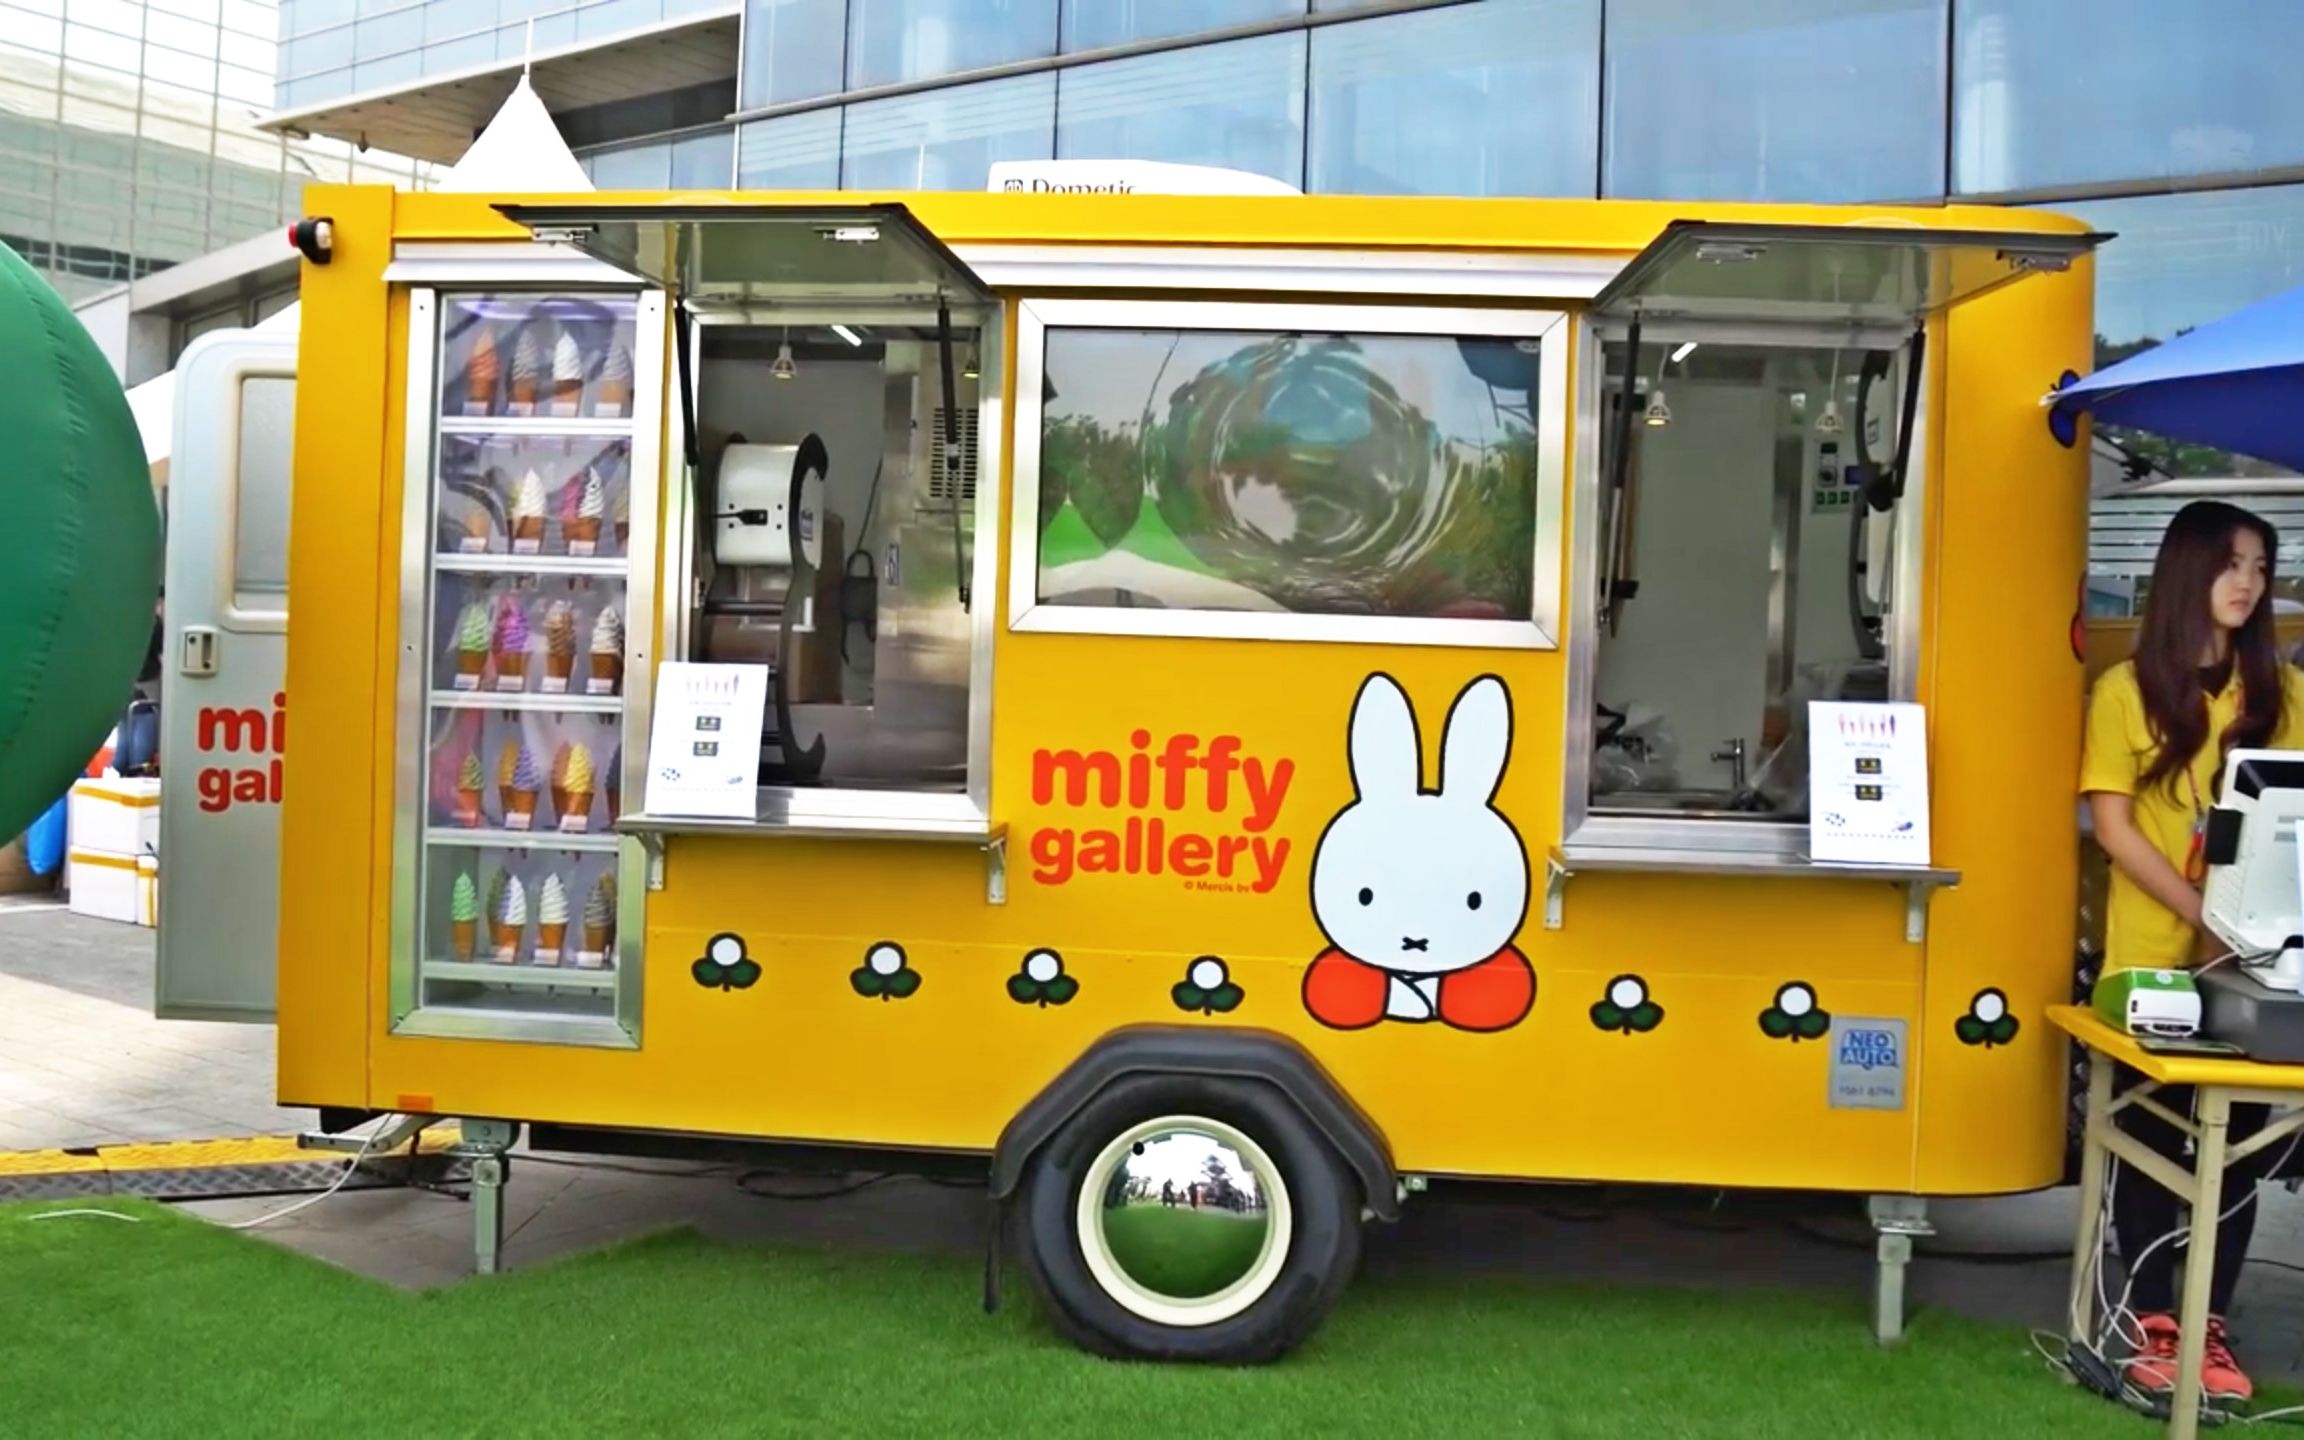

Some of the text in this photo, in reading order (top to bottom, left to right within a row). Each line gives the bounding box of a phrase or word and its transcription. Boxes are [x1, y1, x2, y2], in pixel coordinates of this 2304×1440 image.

[1032, 729, 1295, 833] miffy
[1030, 816, 1291, 894] gallery
[1843, 1048, 1894, 1064] AUTO
[1849, 1031, 1889, 1047] NEO
